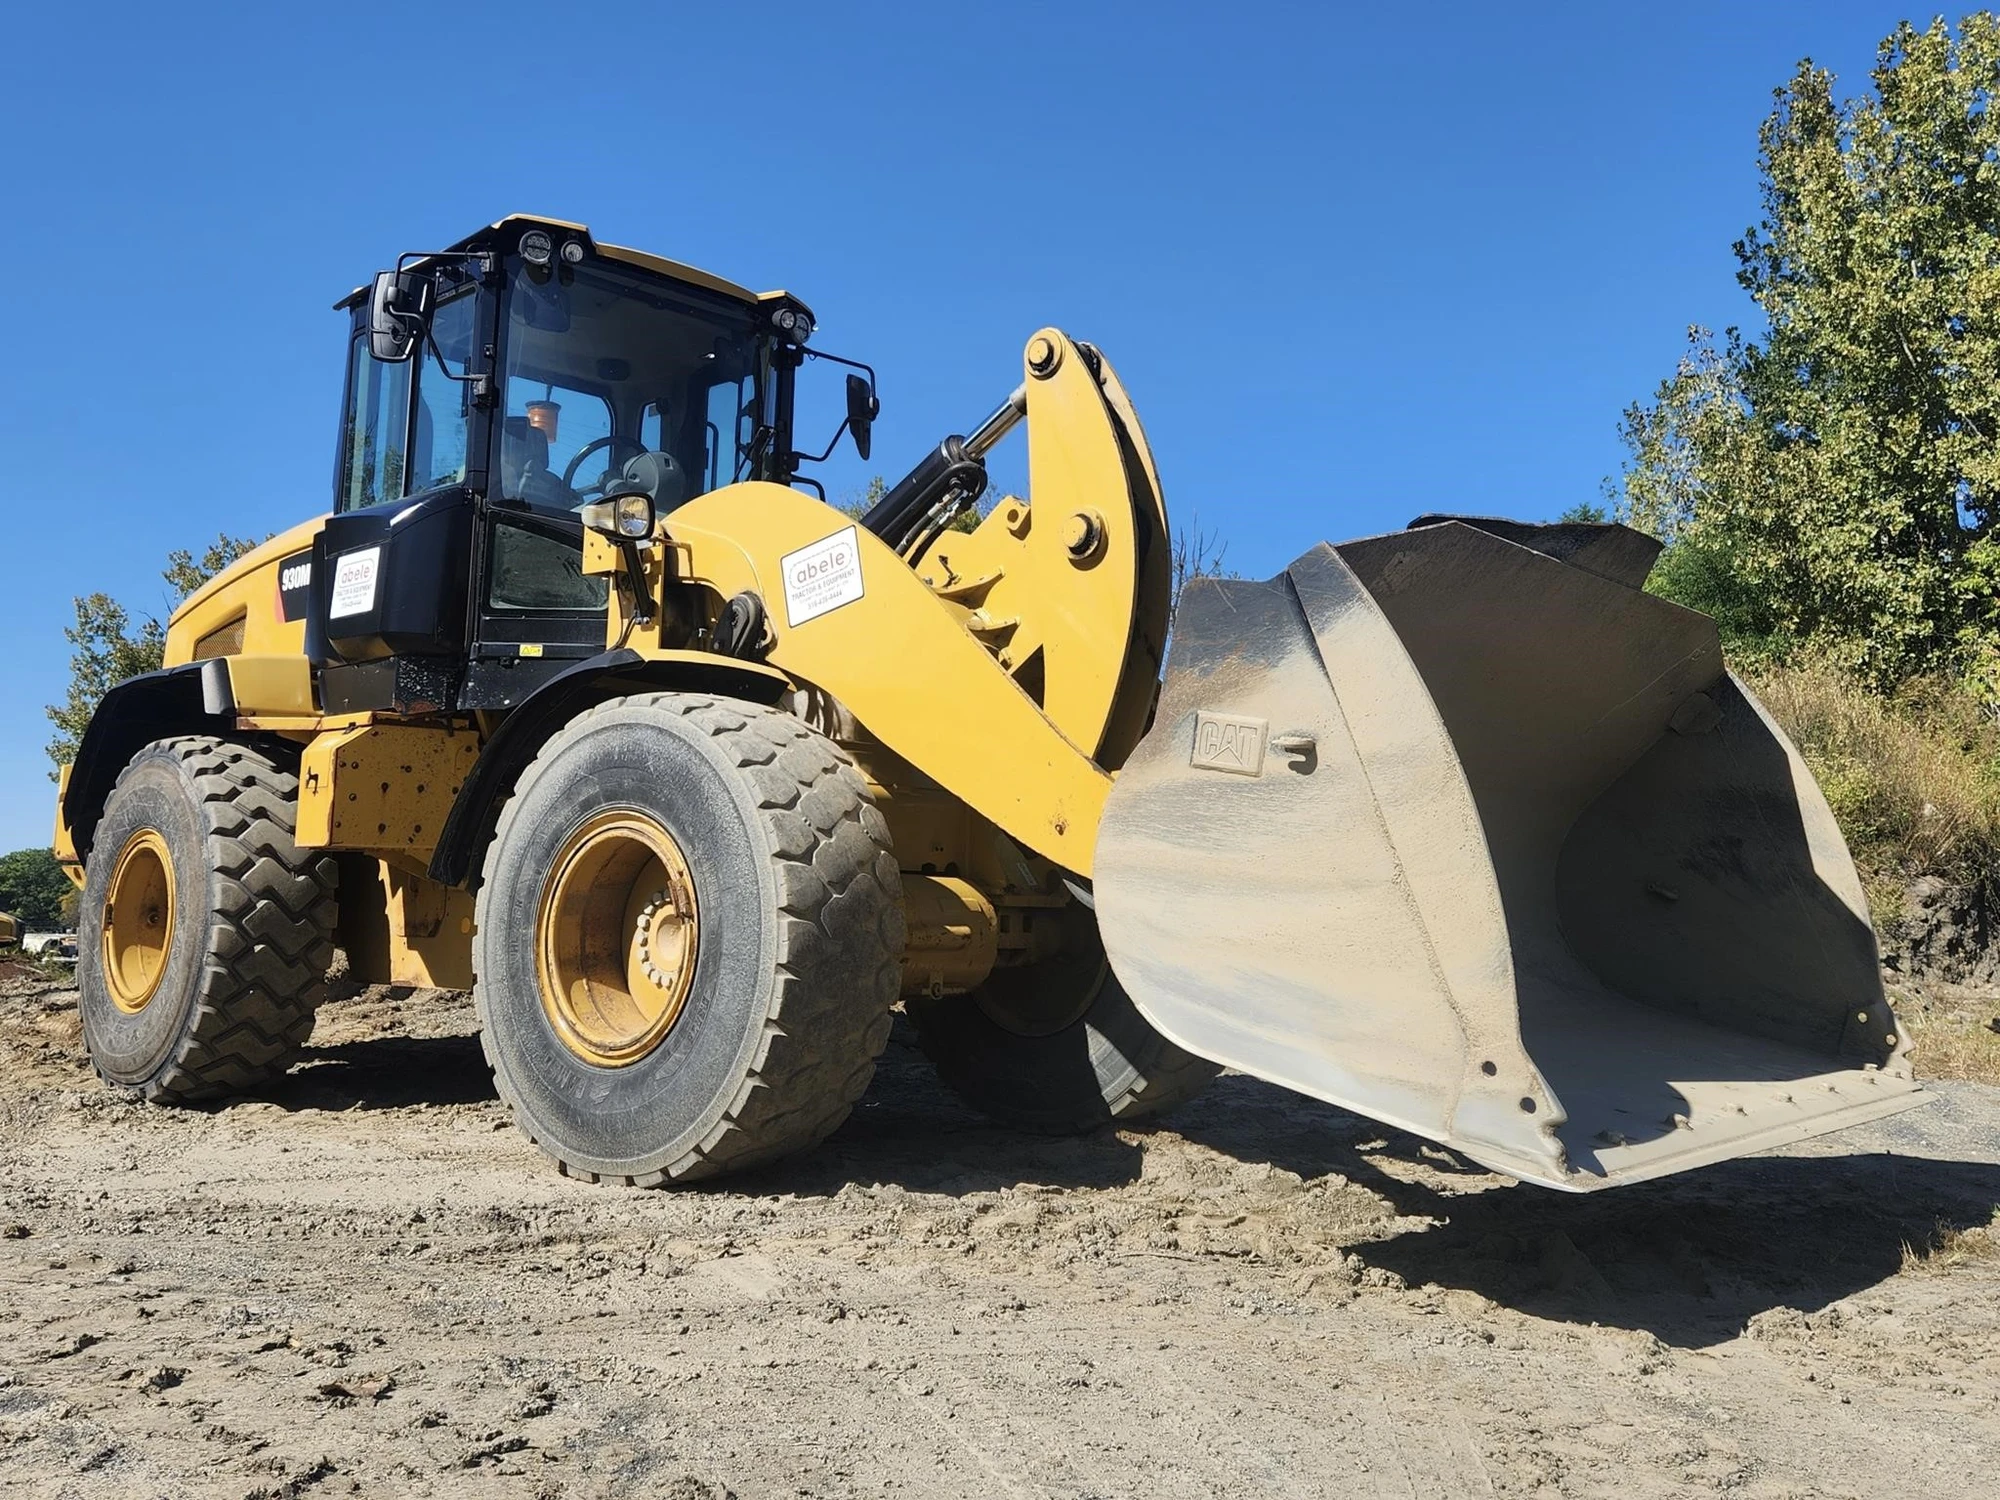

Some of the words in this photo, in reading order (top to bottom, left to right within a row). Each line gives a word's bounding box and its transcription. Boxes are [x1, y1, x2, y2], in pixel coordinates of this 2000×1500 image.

[282, 563, 312, 591] 930M
[341, 564, 370, 584] abele
[797, 552, 845, 583] abele
[1198, 721, 1258, 767] CAT
